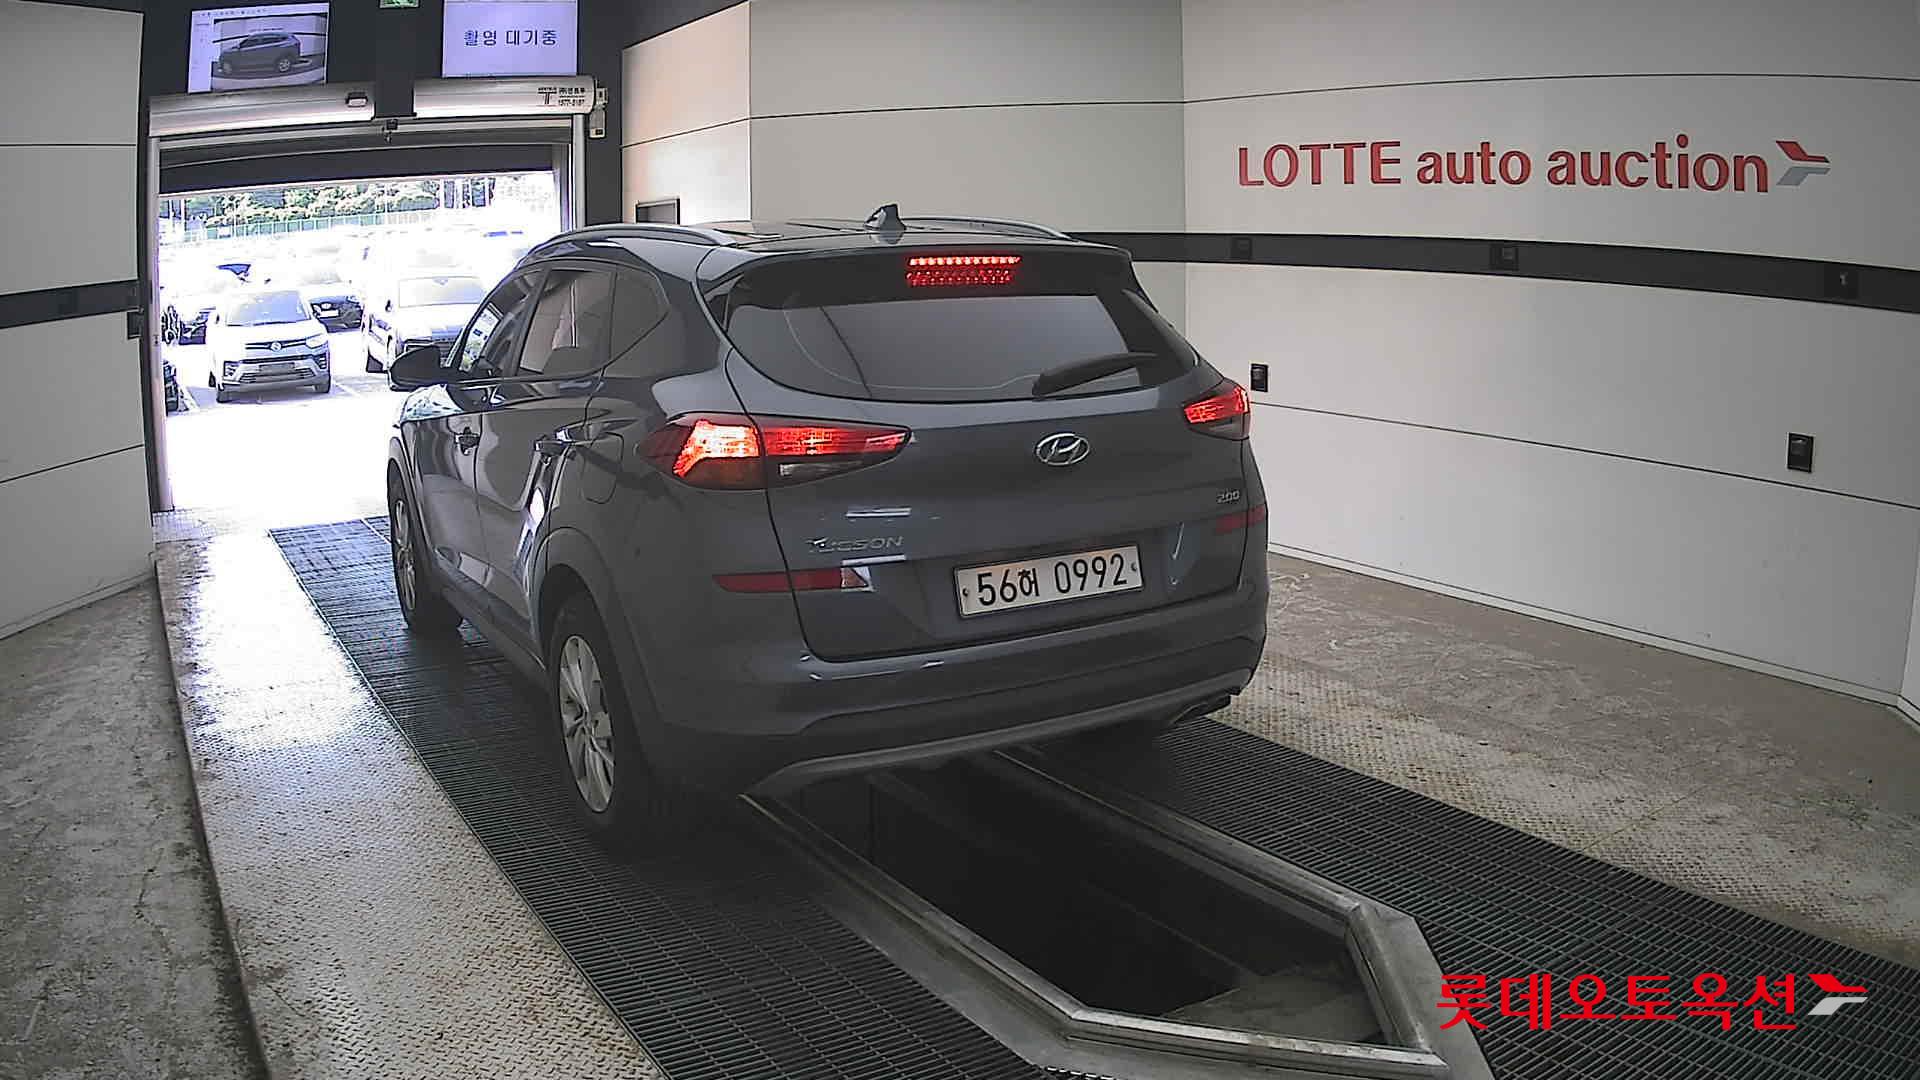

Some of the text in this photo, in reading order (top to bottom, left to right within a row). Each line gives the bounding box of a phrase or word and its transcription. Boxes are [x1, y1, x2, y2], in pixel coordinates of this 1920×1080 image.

[464, 29, 558, 46] 촬영 대기중
[1238, 134, 1769, 193] LOTTE auto auction
[977, 553, 1128, 606] 56허 0992
